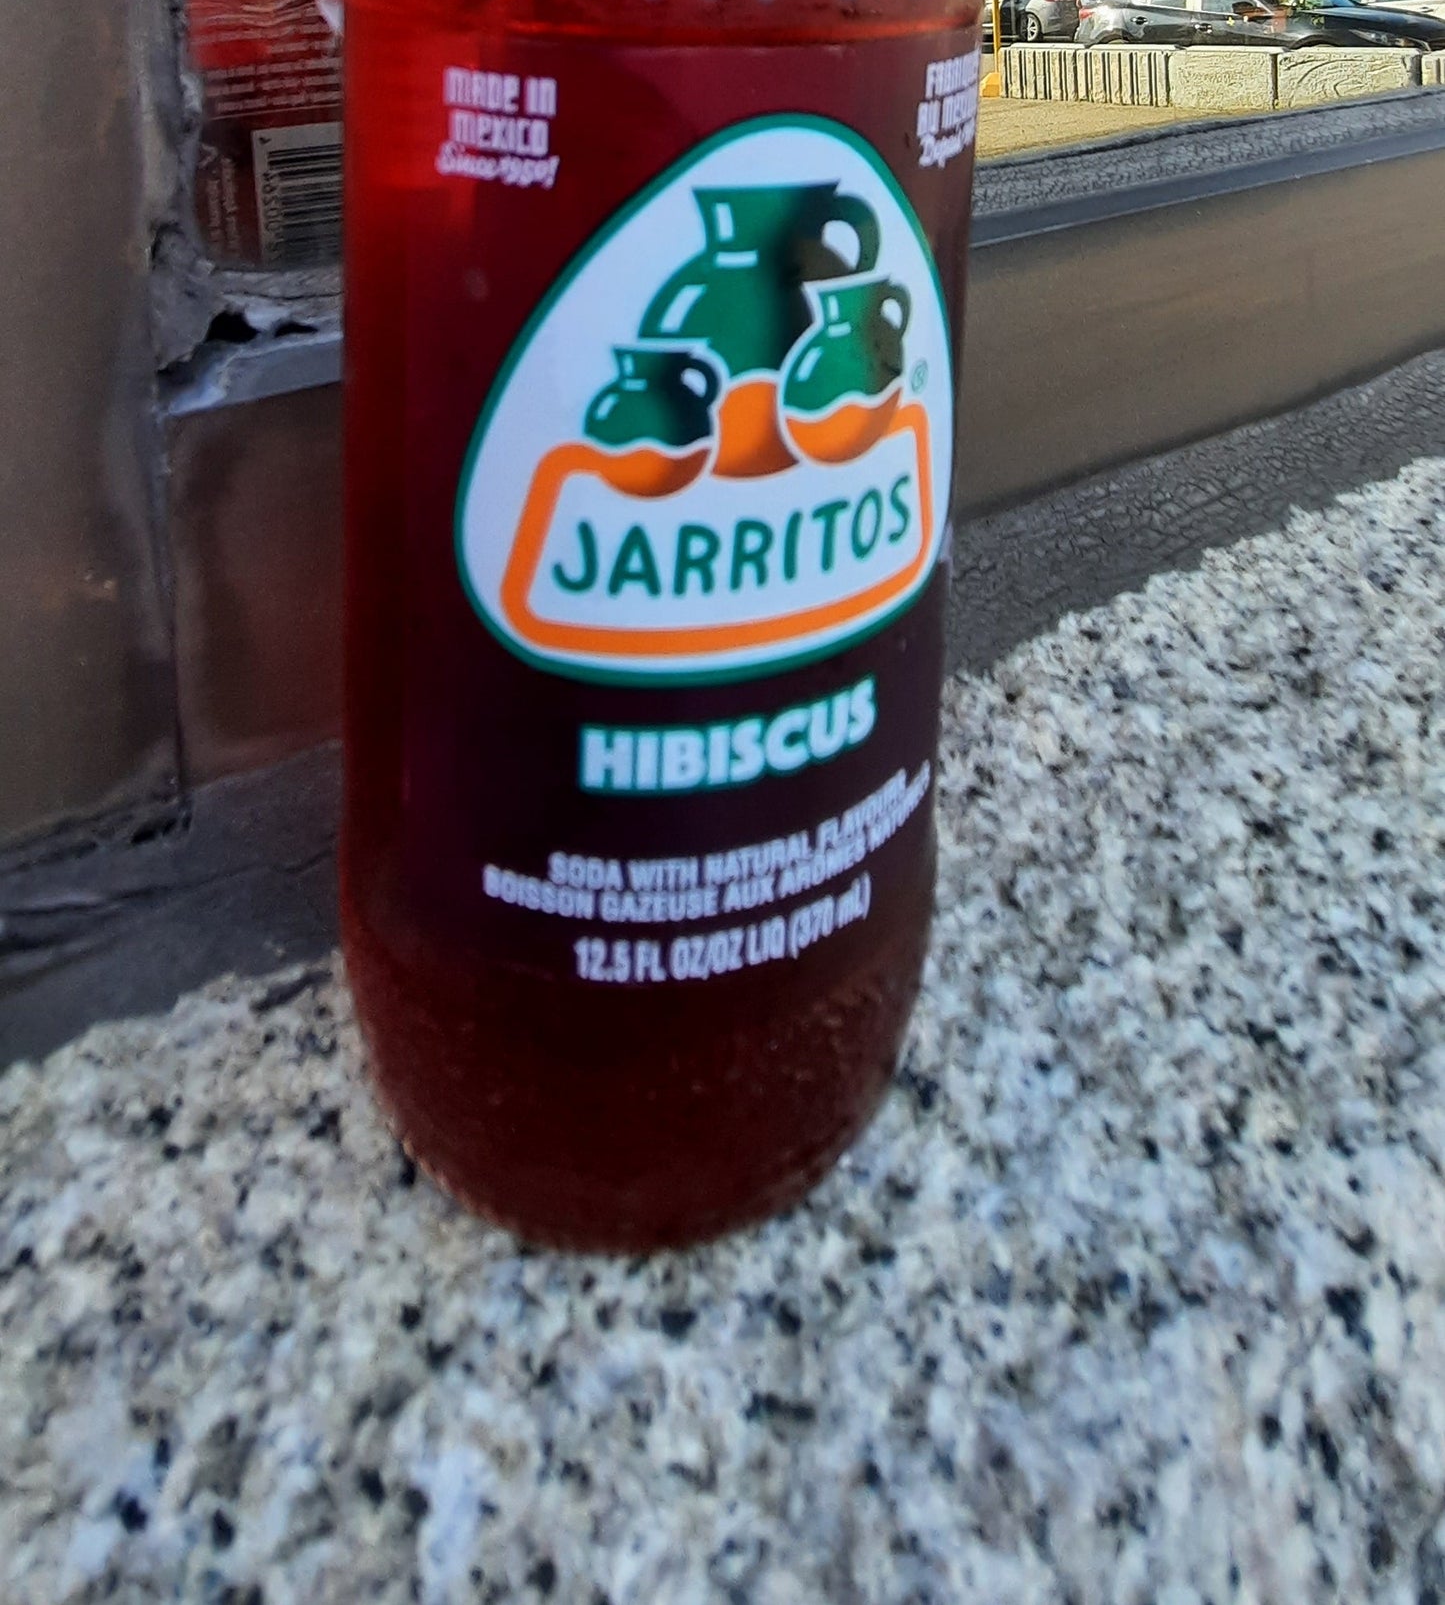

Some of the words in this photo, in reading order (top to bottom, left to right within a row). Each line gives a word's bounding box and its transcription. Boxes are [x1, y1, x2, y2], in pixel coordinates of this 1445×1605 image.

[444, 65, 521, 114] MADE
[524, 76, 558, 119] IN
[448, 107, 550, 157] MEXICO
[551, 474, 911, 597] JARRITOS
[579, 676, 878, 791] HIBISCUS
[483, 862, 595, 920] BOISSON
[600, 885, 719, 923] GAZEUSE
[721, 874, 777, 914] AUX
[549, 850, 624, 891] SODA
[627, 855, 699, 893] WITH
[704, 829, 809, 886] NATURAL
[573, 935, 632, 984] 12.5
[634, 939, 667, 983] FL
[669, 926, 744, 982] OZ/OZ
[787, 894, 834, 960] (370
